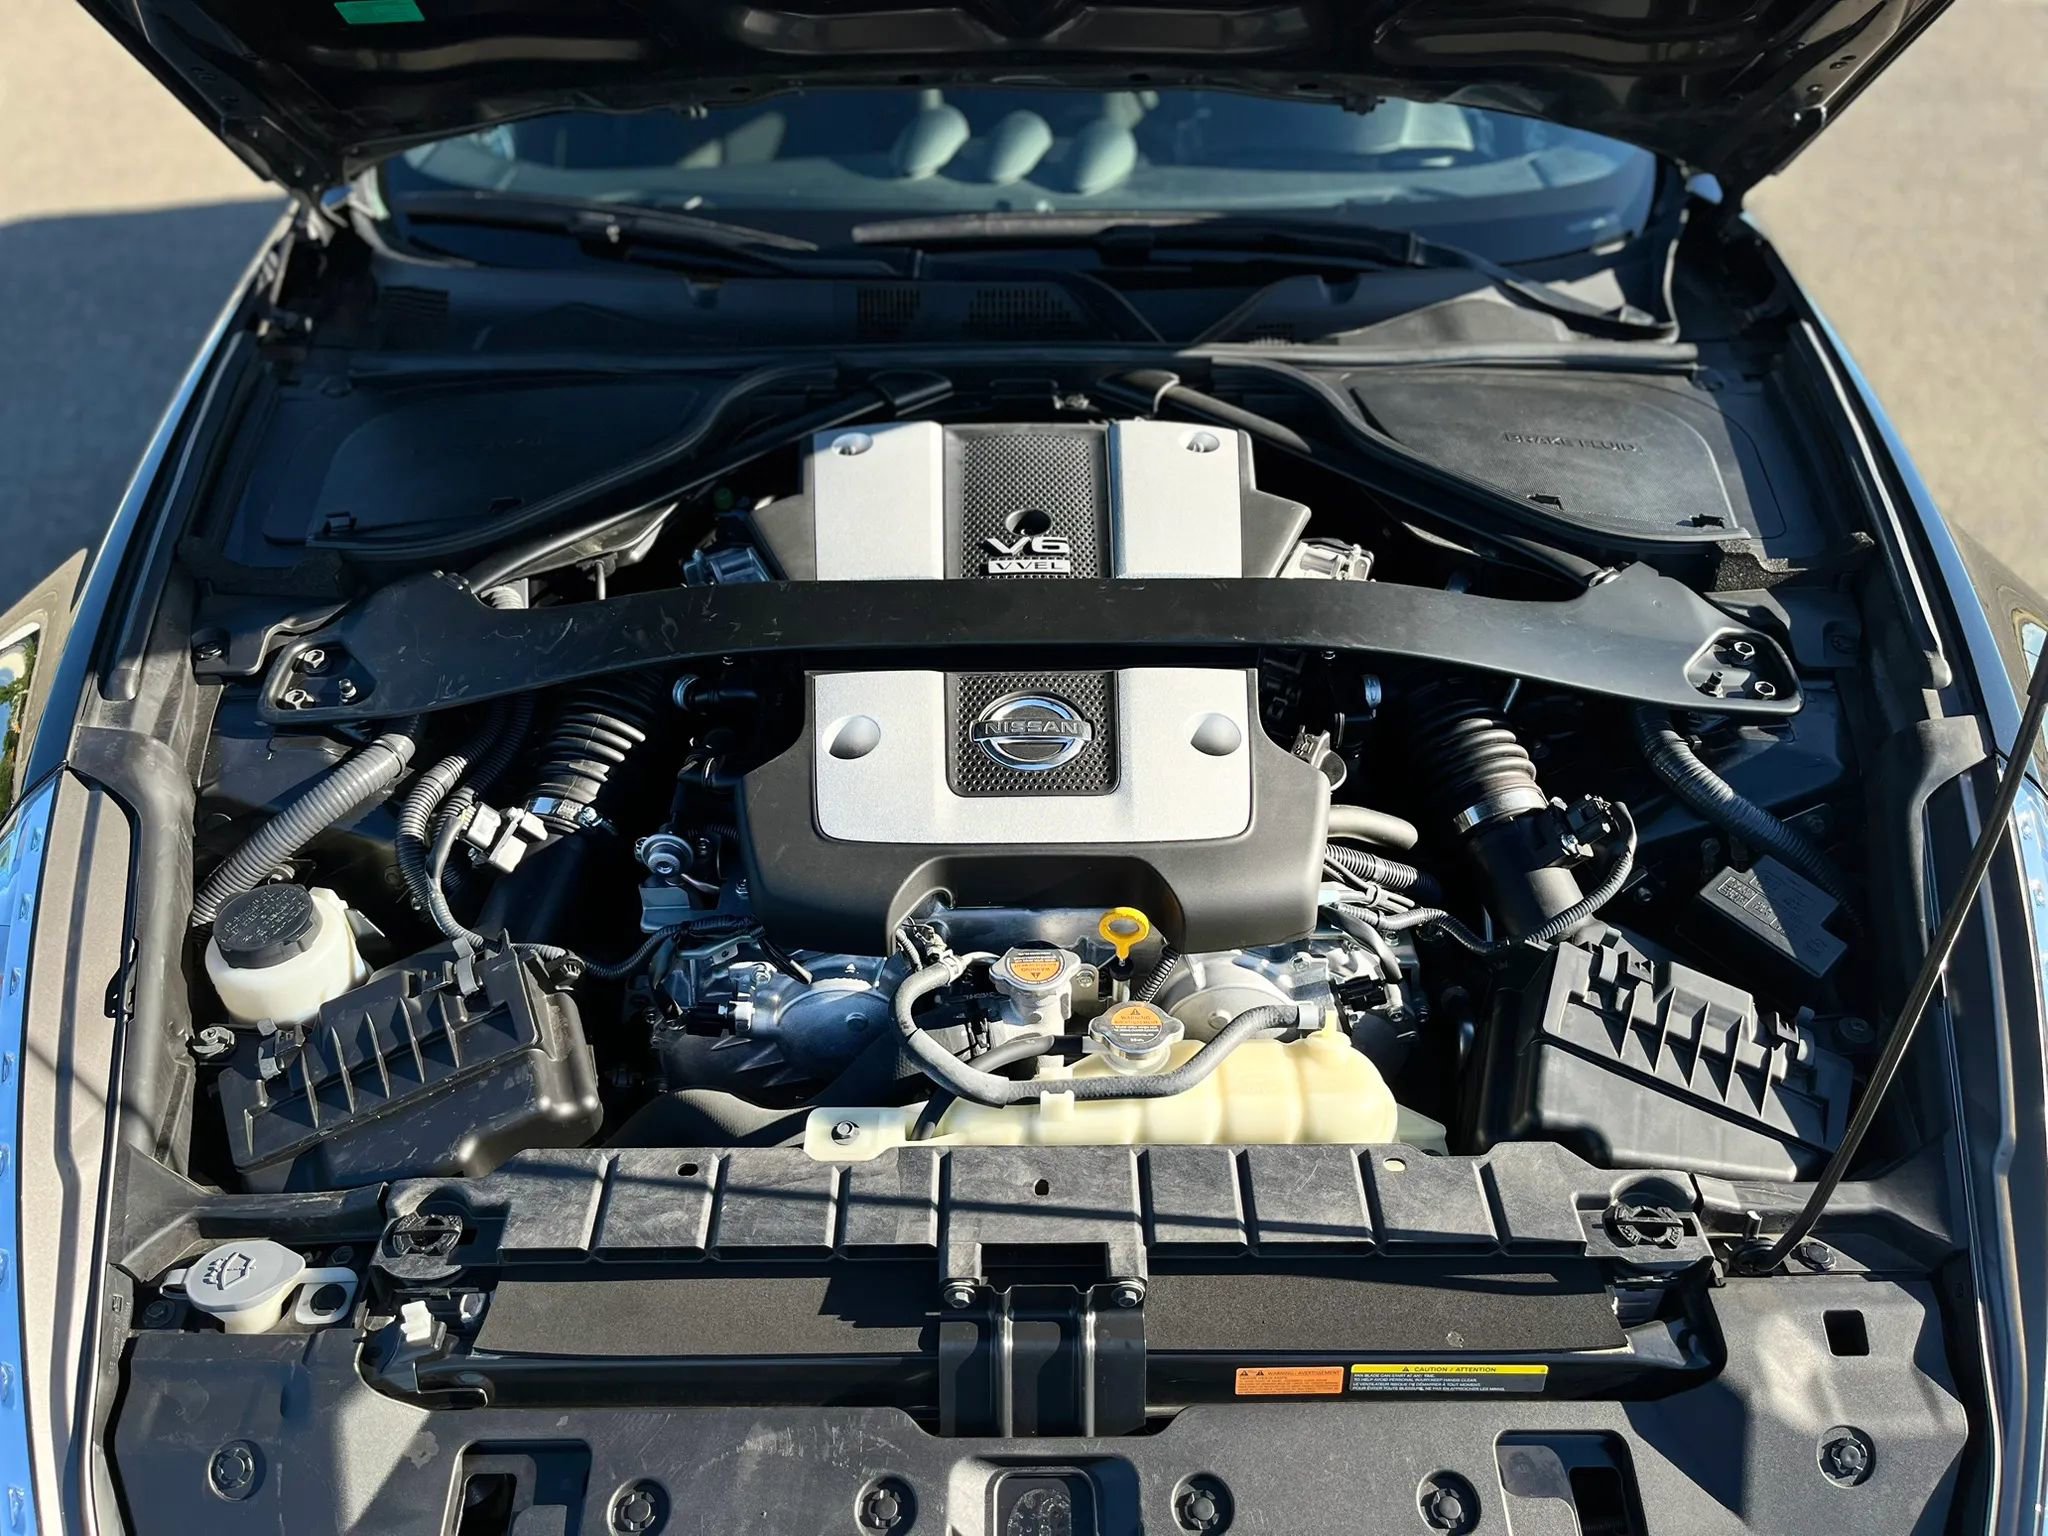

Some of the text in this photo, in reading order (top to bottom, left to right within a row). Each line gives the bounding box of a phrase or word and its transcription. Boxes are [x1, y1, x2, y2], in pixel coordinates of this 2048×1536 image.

[1503, 432, 1637, 452] BRAKE FLUID
[986, 536, 1070, 554] V6
[996, 561, 1065, 570] VVEL
[984, 720, 1079, 735] NISSAN
